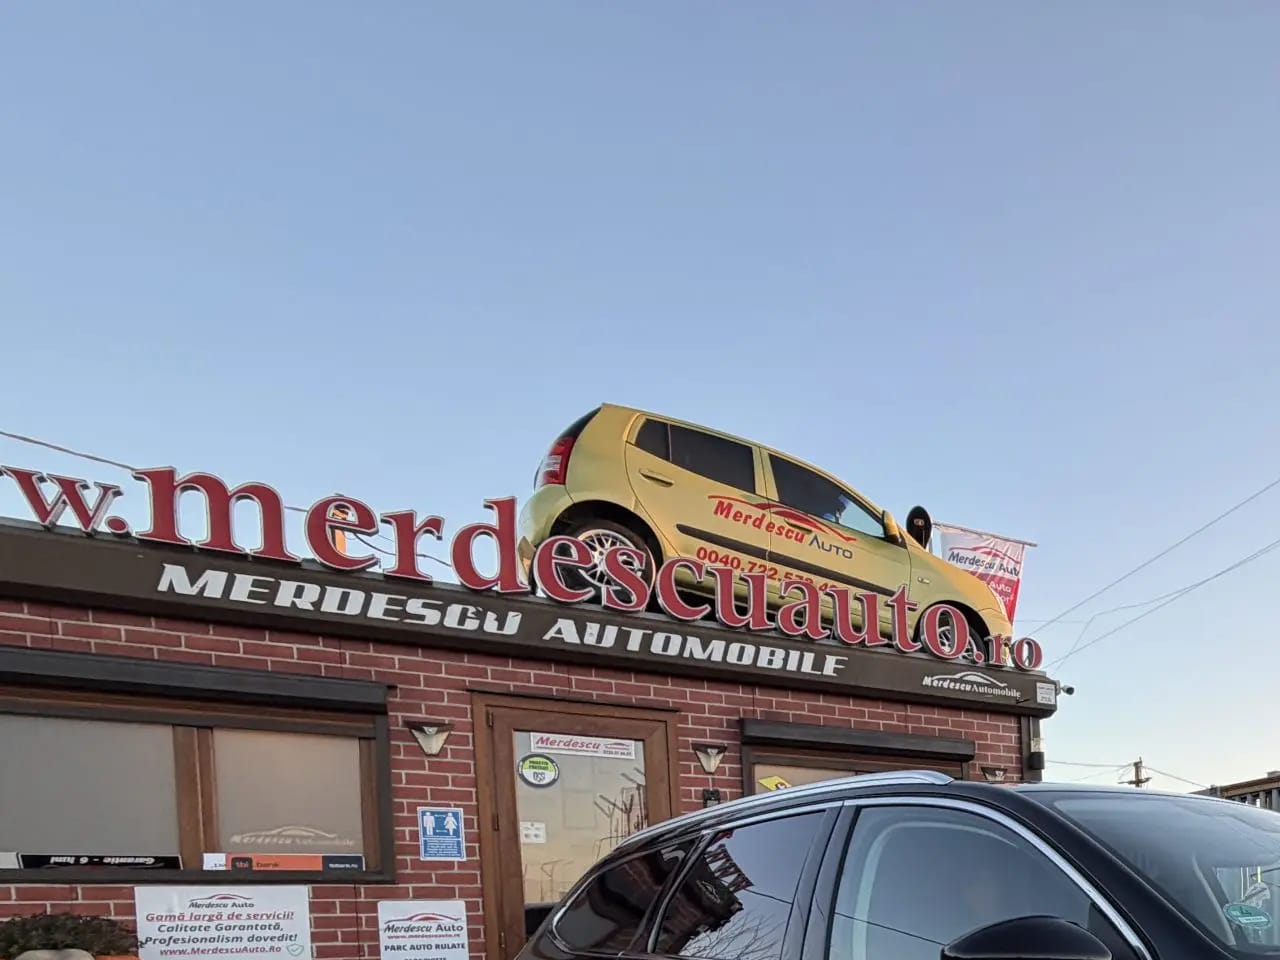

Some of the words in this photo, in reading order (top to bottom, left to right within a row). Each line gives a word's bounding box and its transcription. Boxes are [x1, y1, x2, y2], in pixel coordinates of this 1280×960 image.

[714, 500, 806, 544] Merdescu
[948, 551, 995, 570] Merdescu
[998, 563, 1020, 577] Aut
[157, 563, 522, 636] MERDESCU
[543, 611, 849, 677] AUTOMOBILE
[536, 736, 602, 749] Merdescu
[79, 856, 89, 864] 6
[103, 856, 155, 864] Garantie
[188, 901, 229, 909] Merdescu
[145, 912, 186, 922] Gamă
[227, 911, 242, 920] de
[245, 911, 294, 921] servicii!
[157, 923, 212, 933] Calitate
[384, 924, 433, 933] Merdescu
[435, 923, 464, 932] Auto
[144, 933, 243, 946] Profesionalism
[247, 933, 298, 943] dovedit!
[384, 944, 408, 952] PARC
[409, 943, 433, 951] AUTO
[434, 942, 466, 950] RULATE
